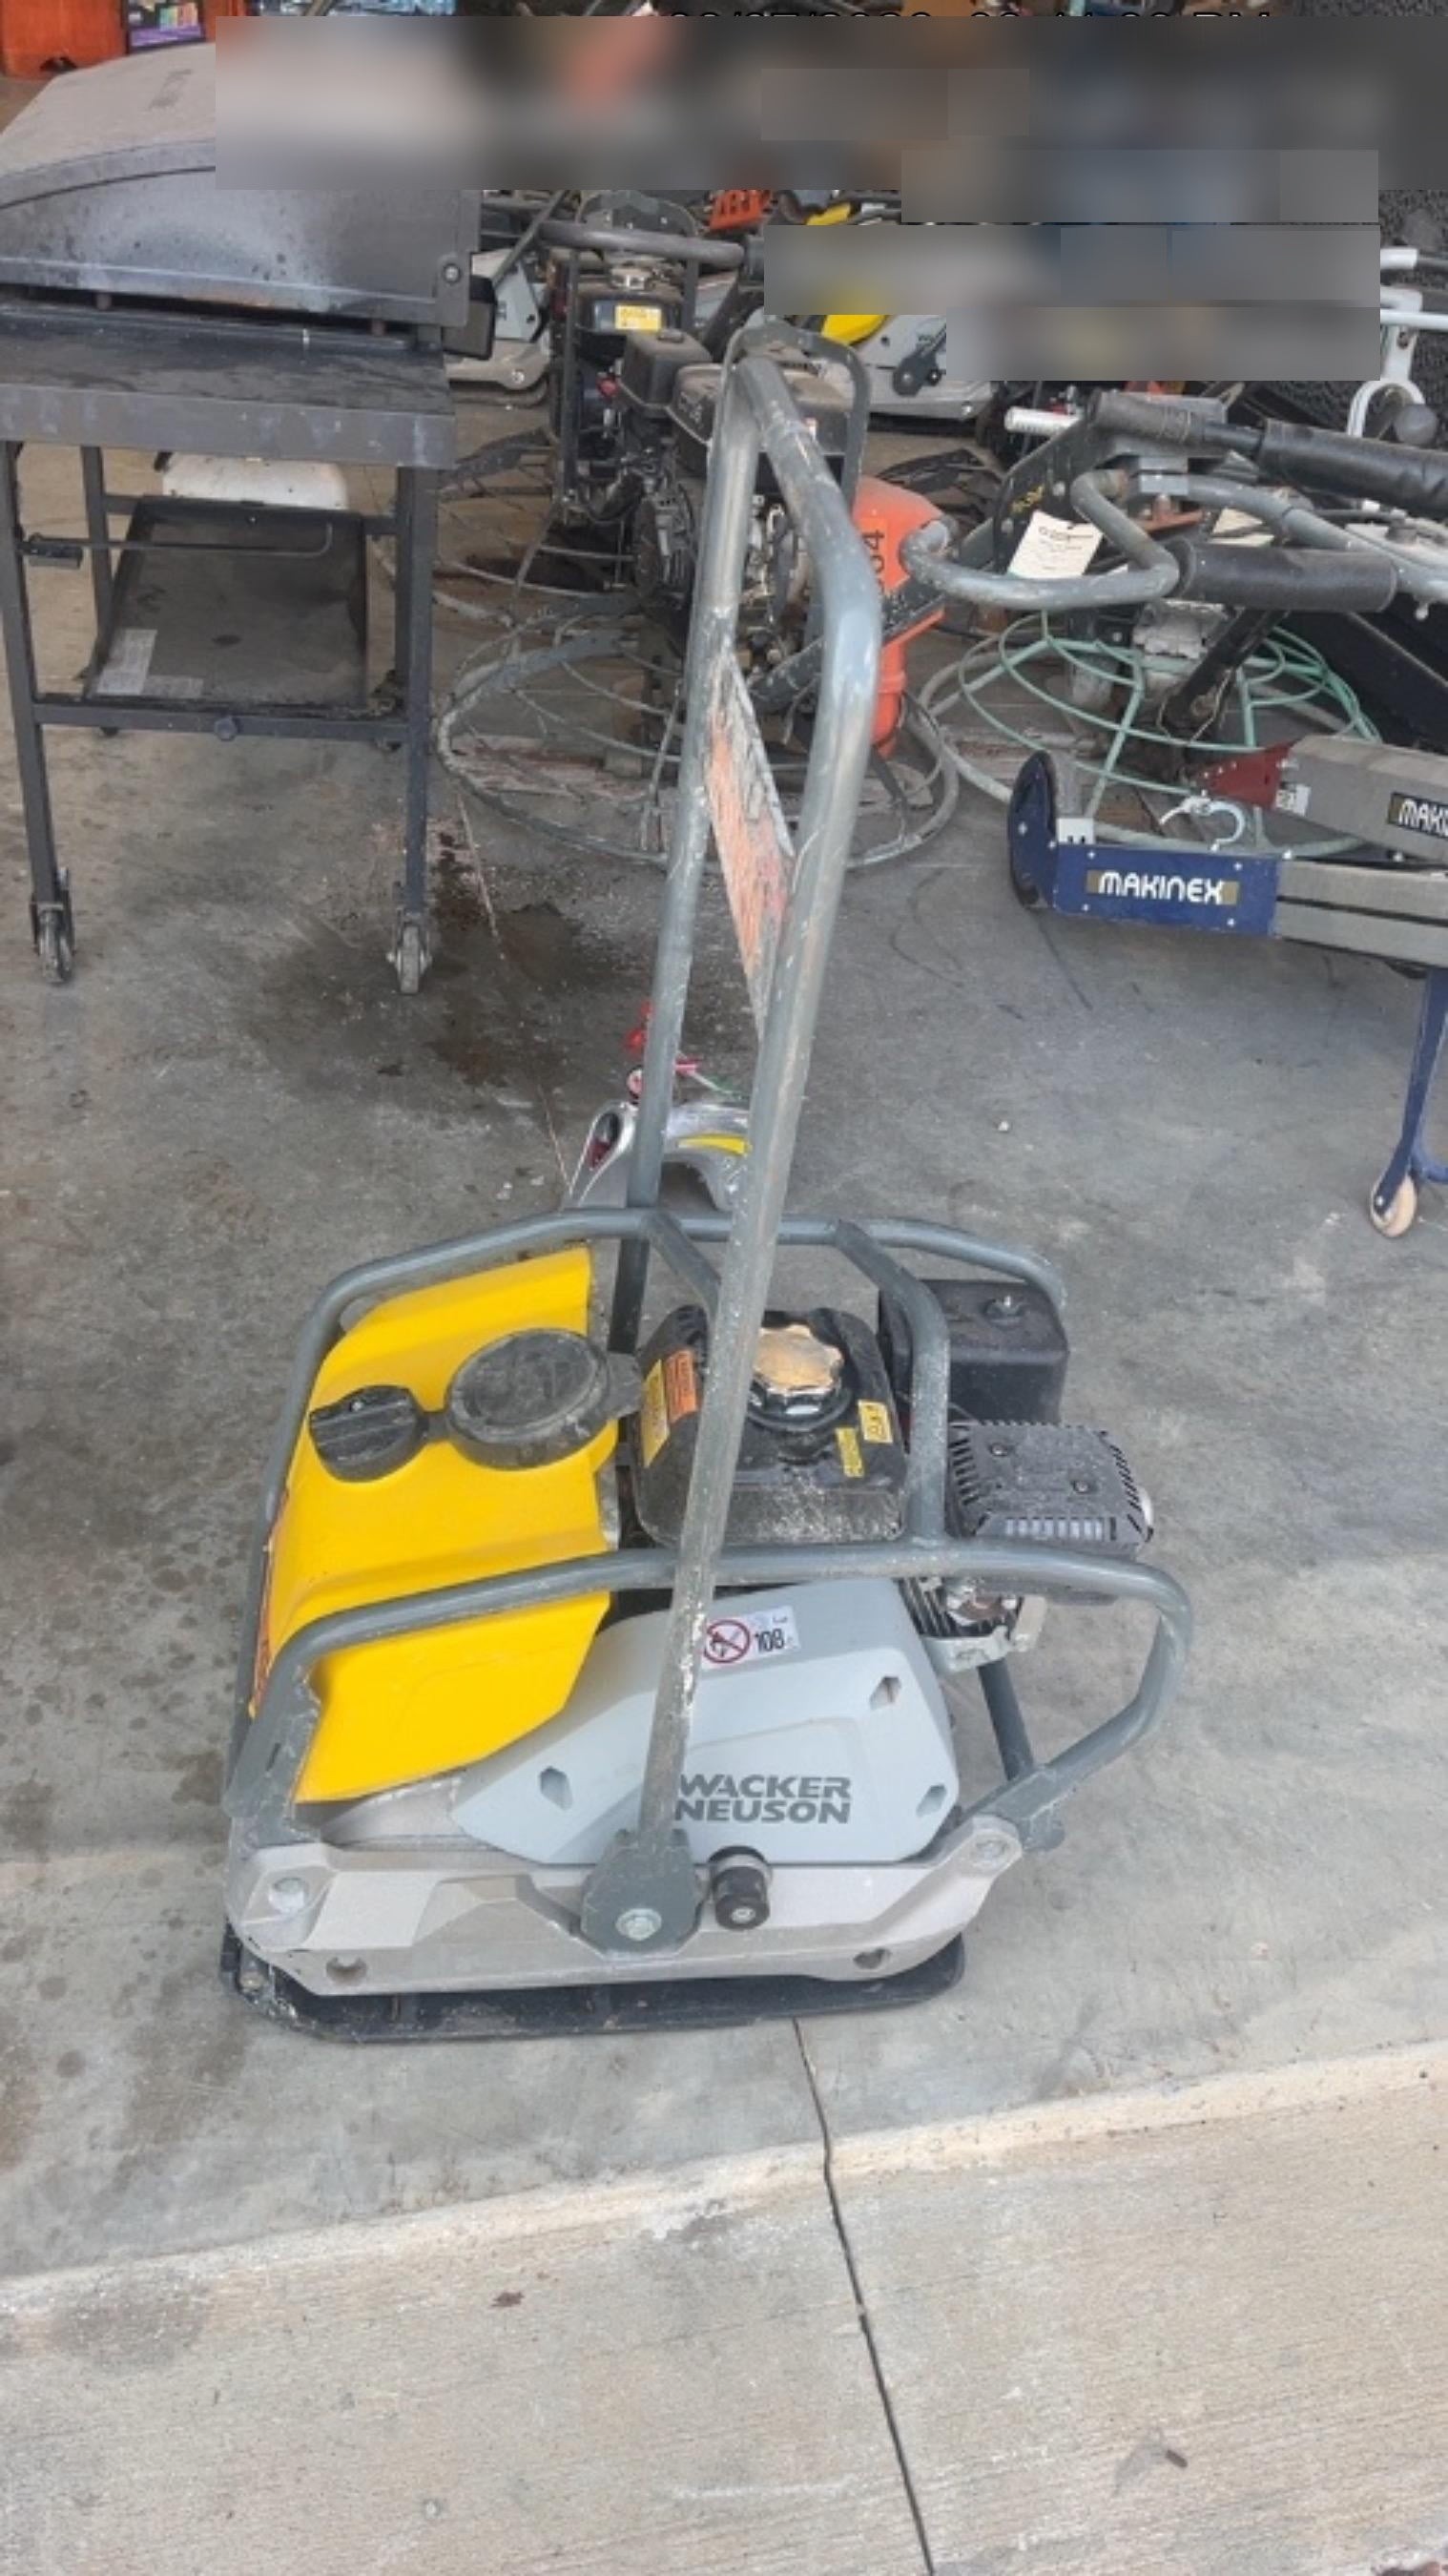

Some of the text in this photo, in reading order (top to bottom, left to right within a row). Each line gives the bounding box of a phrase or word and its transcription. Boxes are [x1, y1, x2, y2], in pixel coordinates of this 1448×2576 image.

[1098, 870, 1225, 905] MAKINEX
[754, 1627, 784, 1653] 108
[679, 1774, 852, 1798] WACKER
[673, 1798, 851, 1824] NEUSON
